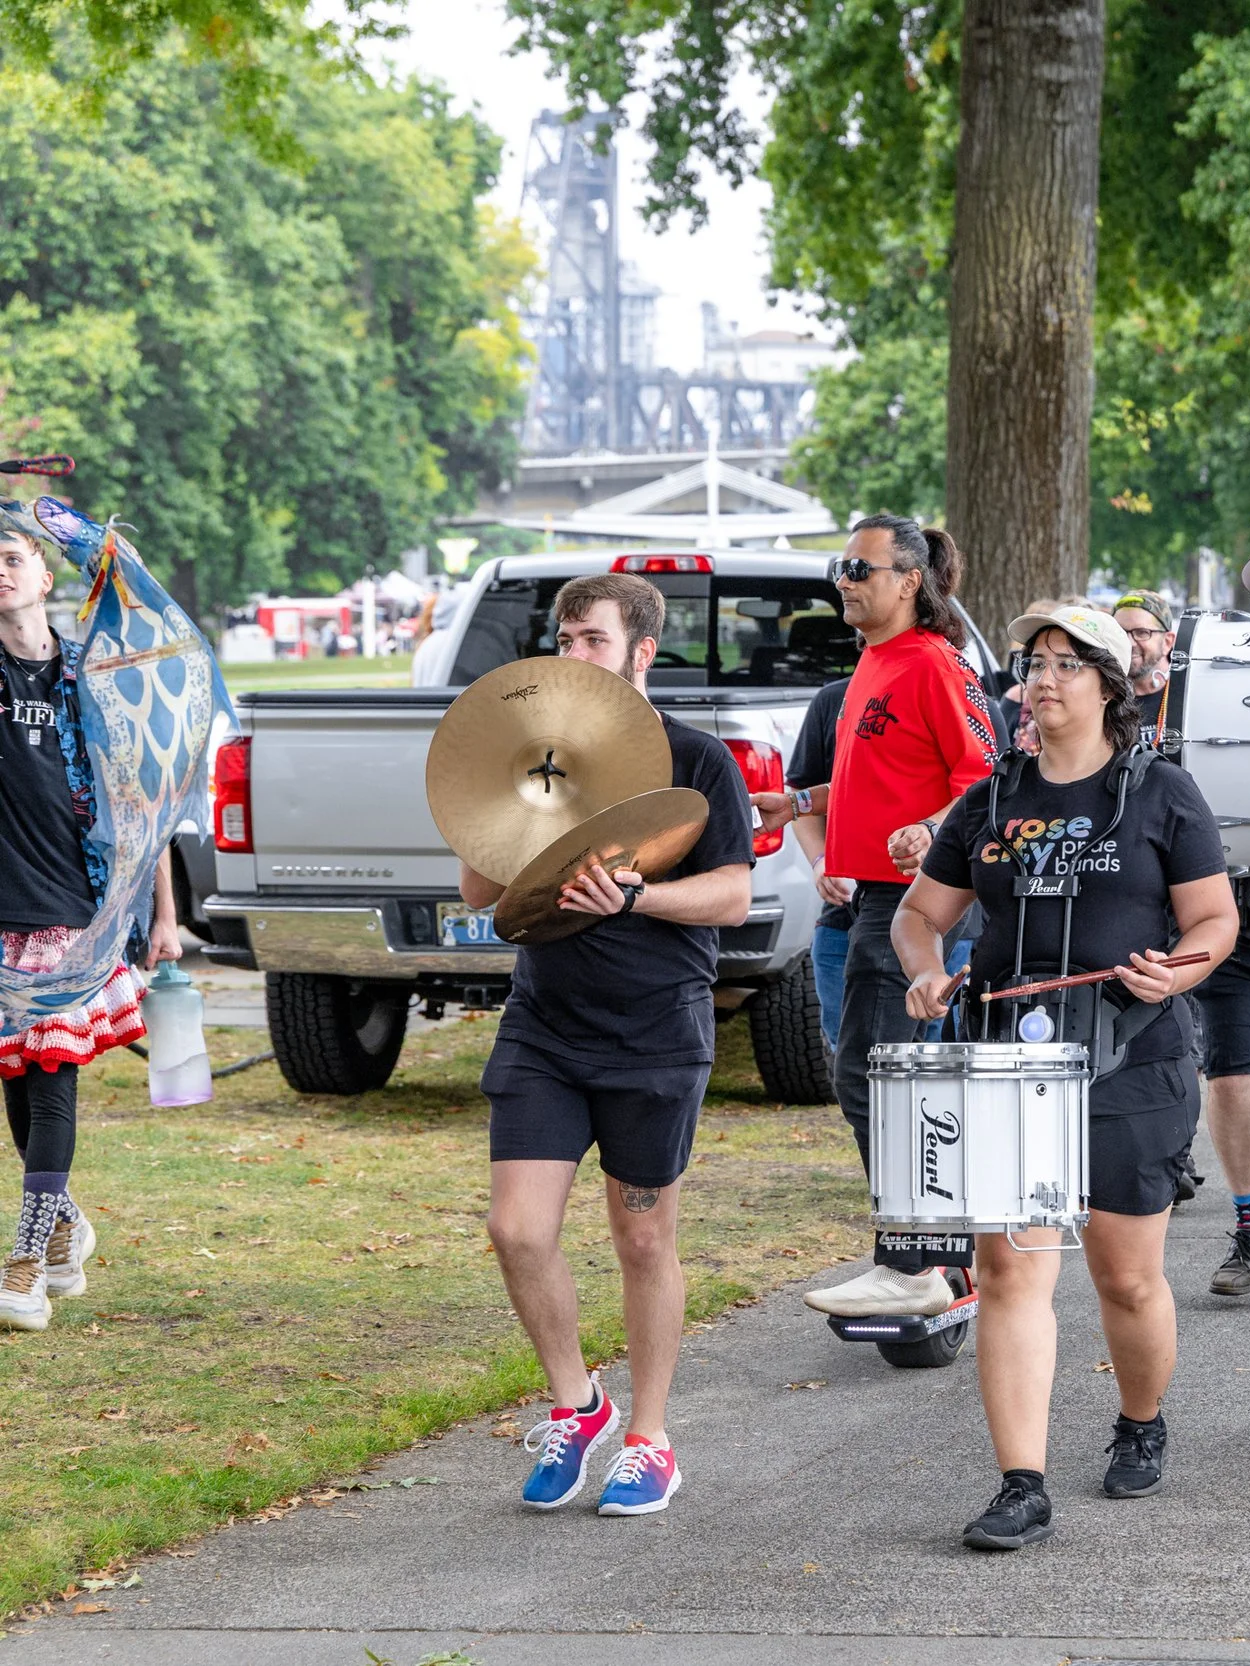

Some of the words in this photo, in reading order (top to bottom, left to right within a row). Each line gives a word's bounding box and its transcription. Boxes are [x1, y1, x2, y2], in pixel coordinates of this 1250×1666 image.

[1004, 816, 1093, 840] rose
[271, 866, 394, 877] SILVERADO
[1022, 876, 1065, 896] Pearl
[920, 1096, 961, 1202] Pearl
